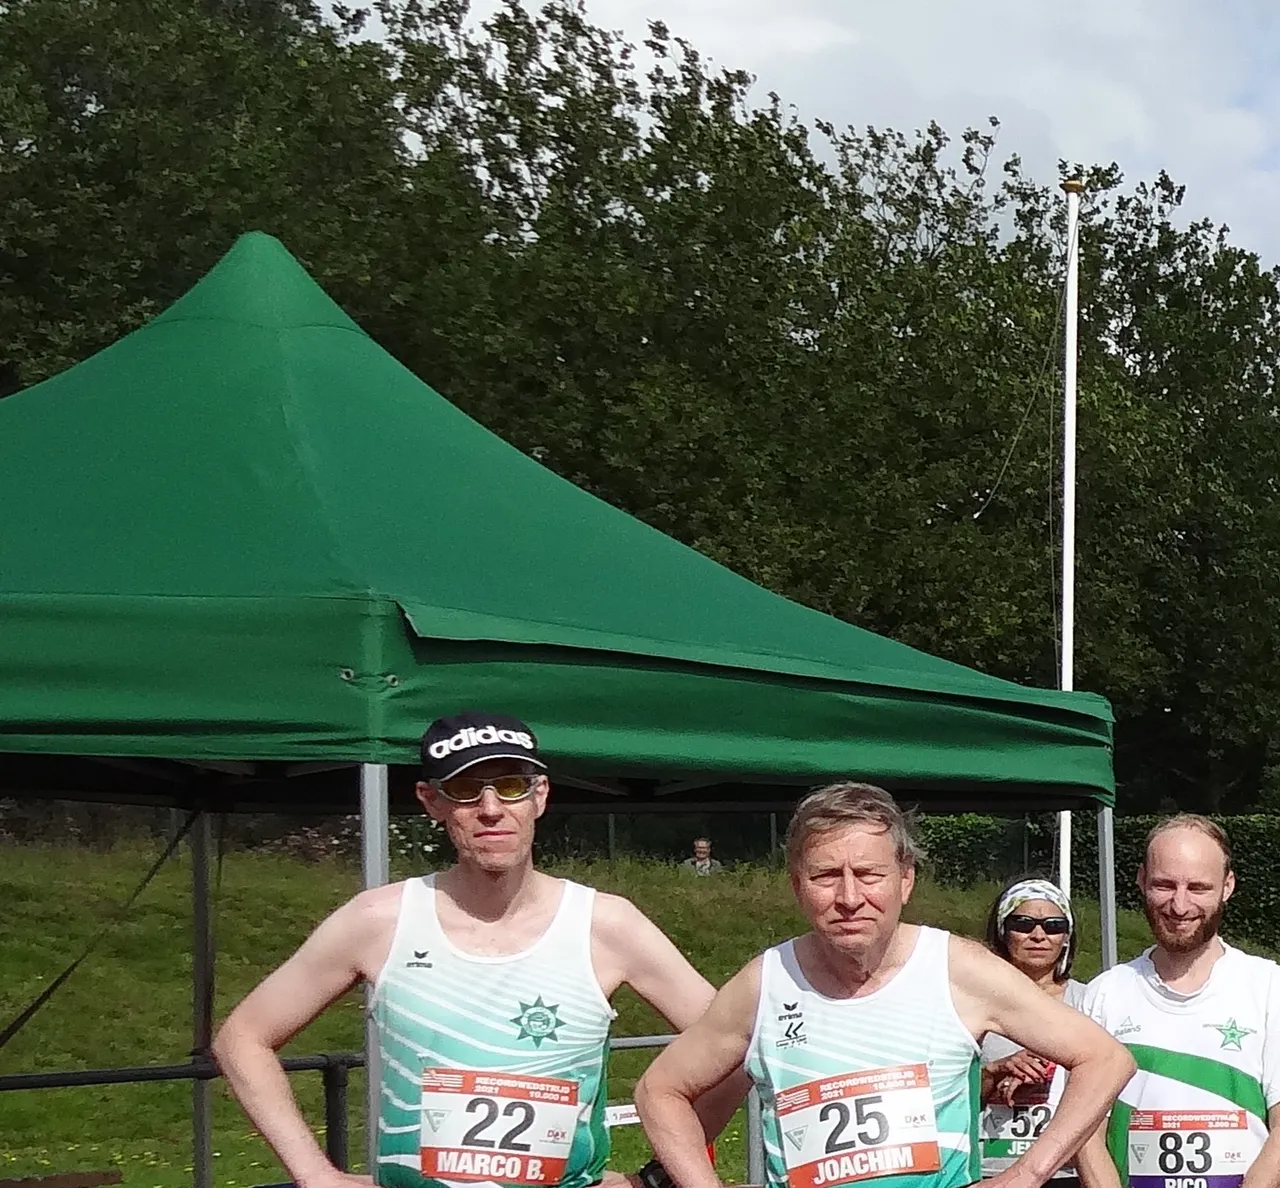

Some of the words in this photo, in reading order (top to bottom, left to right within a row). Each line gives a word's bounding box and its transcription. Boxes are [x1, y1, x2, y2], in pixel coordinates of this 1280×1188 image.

[429, 725, 534, 759] adidas
[461, 1097, 536, 1152] 22
[819, 1095, 890, 1155] 25
[1010, 1105, 1052, 1138] 52
[437, 1151, 515, 1178] MARCO
[526, 1159, 545, 1181] B.
[814, 1146, 914, 1185] JOACHIM
[1158, 1132, 1213, 1174] 83
